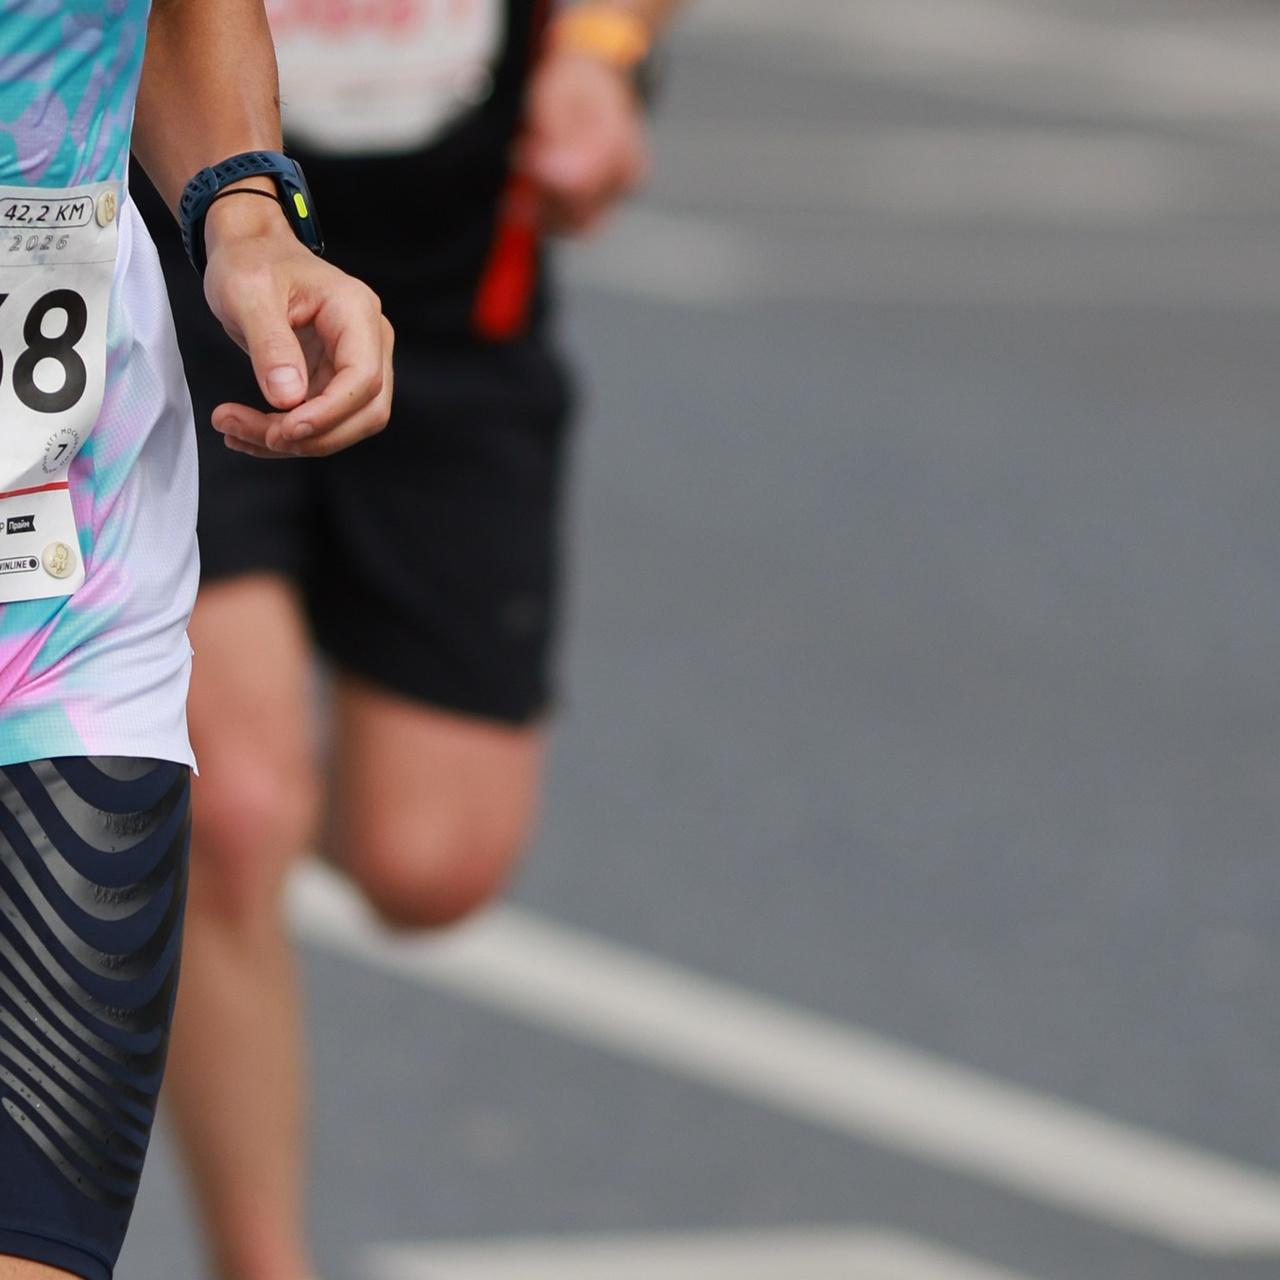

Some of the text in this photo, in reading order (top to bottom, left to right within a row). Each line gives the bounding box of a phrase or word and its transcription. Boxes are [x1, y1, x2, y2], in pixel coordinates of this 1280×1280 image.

[4, 203, 85, 224] 42,2 КМ
[9, 234, 70, 252] 2026
[53, 443, 68, 461] 7
